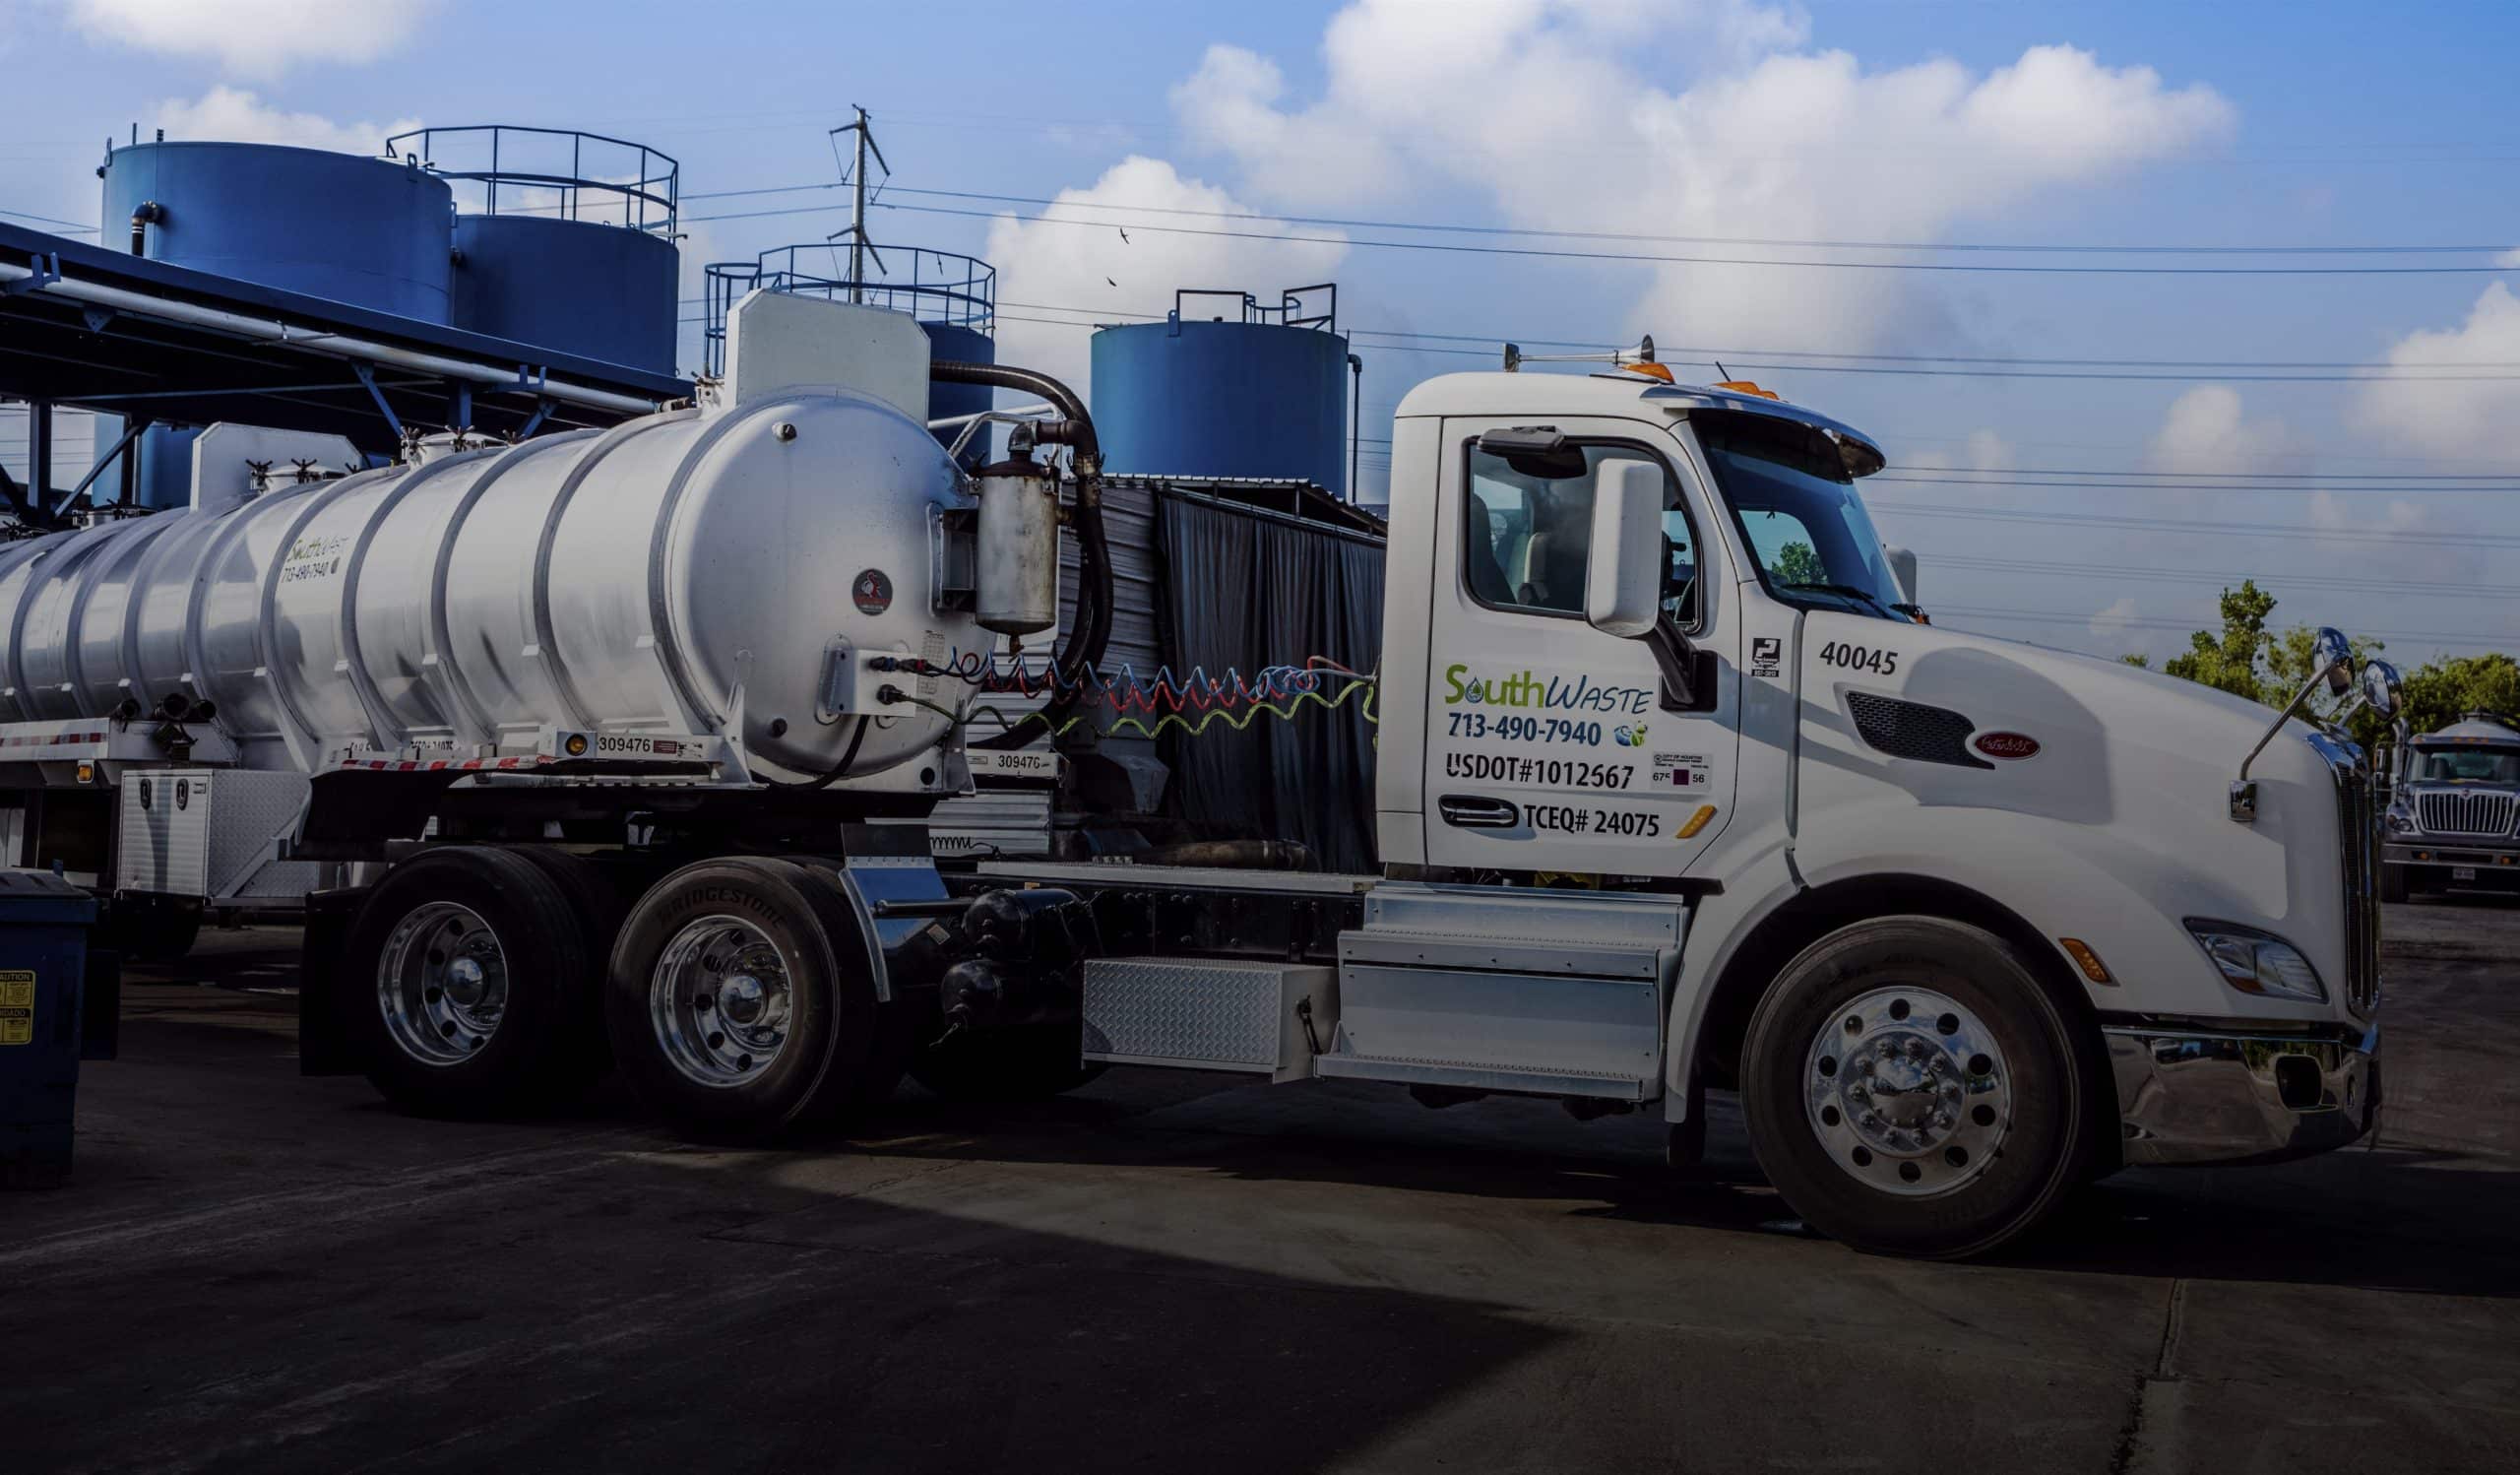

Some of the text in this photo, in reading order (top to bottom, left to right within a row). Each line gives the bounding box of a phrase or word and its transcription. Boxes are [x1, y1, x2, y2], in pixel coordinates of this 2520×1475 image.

[1819, 641, 1898, 675] 40045
[598, 737, 651, 752] 309476
[1448, 712, 1602, 747] 713-490-7940
[1524, 804, 1660, 837] TCEQ# 24075
